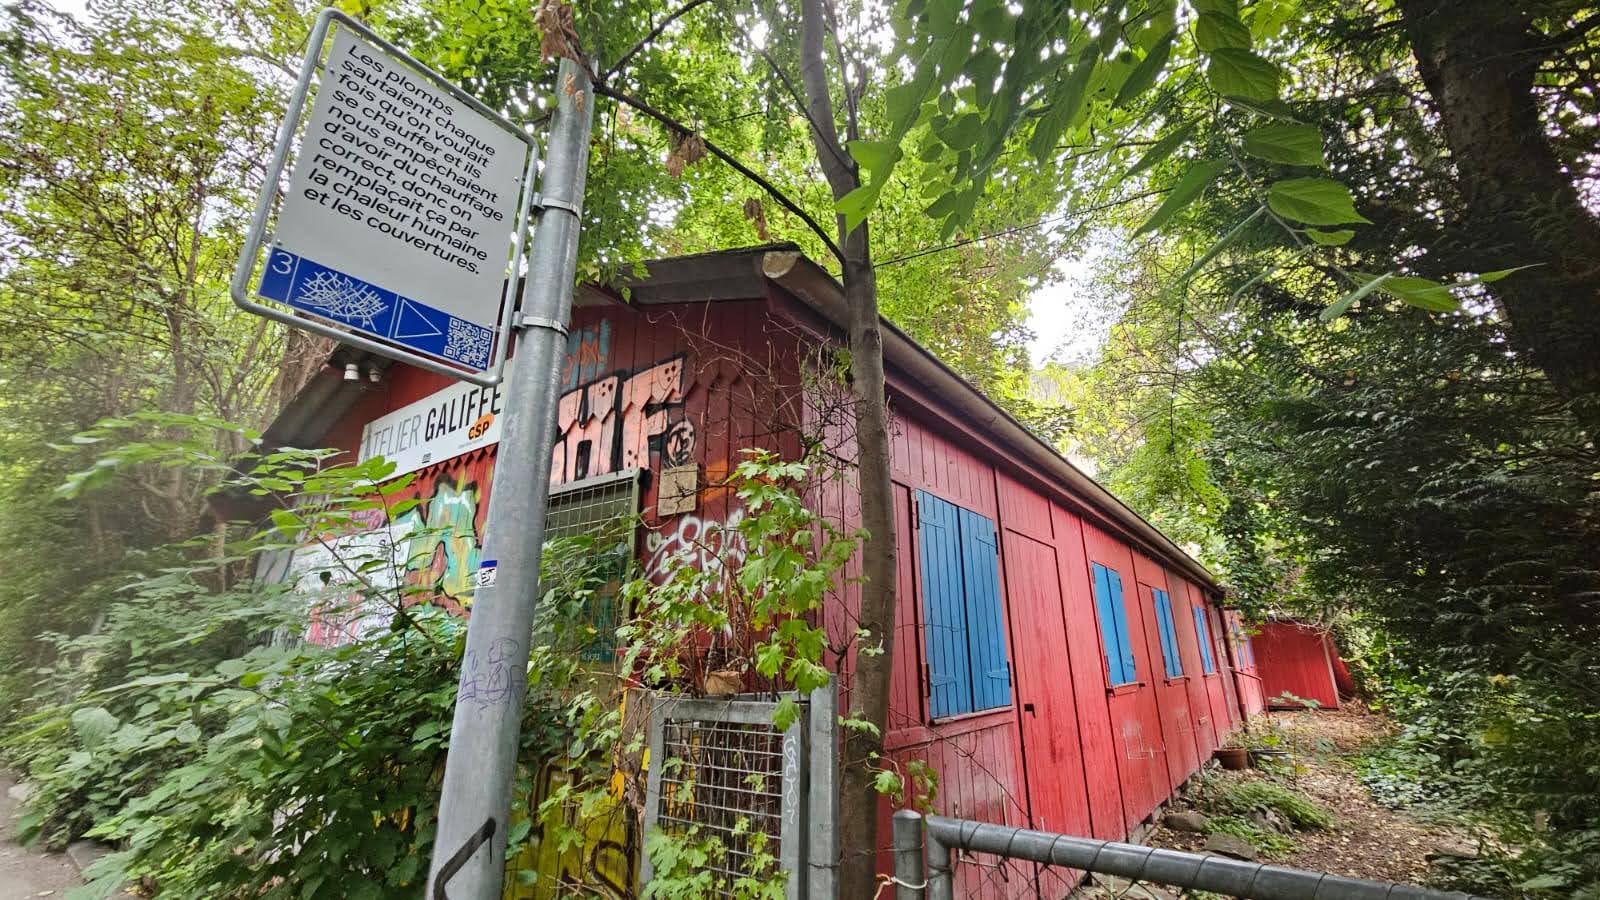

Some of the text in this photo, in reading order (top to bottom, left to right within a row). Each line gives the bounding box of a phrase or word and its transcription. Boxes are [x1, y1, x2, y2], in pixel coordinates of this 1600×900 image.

[339, 73, 490, 168] fois qu'on voulait
[341, 60, 496, 156] sautaient chaque
[348, 45, 454, 116] Les plombs
[324, 121, 504, 221] d'avoir du chauffage
[328, 105, 499, 204] nous empêchaient
[332, 90, 482, 179] se chauffer et ils
[308, 168, 488, 261] la chaleur humaine
[313, 153, 480, 239] remplaçait ça par
[319, 138, 473, 221] correct, donc on
[272, 252, 293, 275] 3
[303, 188, 480, 275] et les couvertures.
[468, 420, 490, 441] CSP
